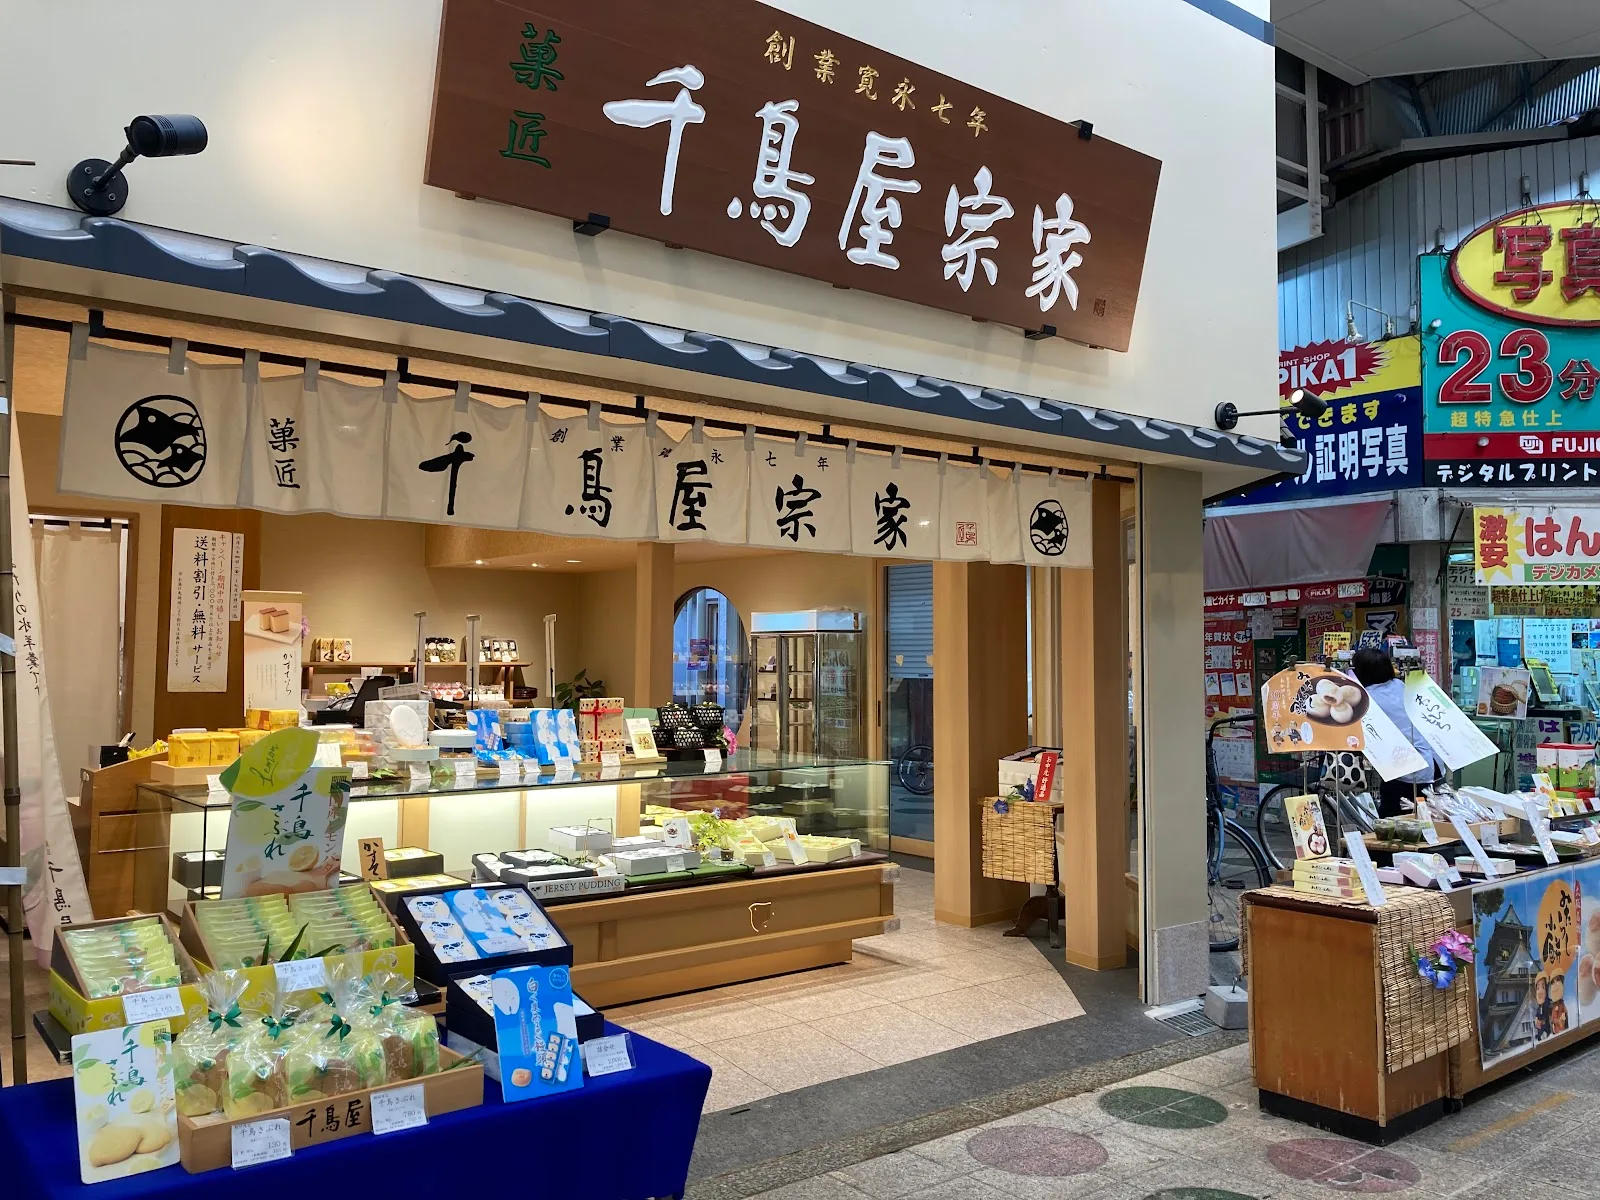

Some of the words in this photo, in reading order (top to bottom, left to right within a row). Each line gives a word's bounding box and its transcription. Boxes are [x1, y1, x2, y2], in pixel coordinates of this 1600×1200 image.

[498, 23, 566, 170] 菓匠
[763, 30, 990, 138] 創業寛永七年
[602, 64, 1093, 313] 千鳥屋宗家
[1494, 221, 1600, 303] 写真
[1303, 352, 1331, 364] SHOP
[1281, 399, 1381, 430] できます
[1450, 409, 1563, 428] 超特急仕上
[267, 417, 301, 490] 菓匠
[1436, 462, 1598, 484] デジタルプリント
[418, 430, 911, 552] 千鳥屋宗家
[1479, 514, 1509, 570] 激安
[1524, 515, 1600, 558] はん
[1491, 588, 1544, 603] 超特急仕上げ
[1532, 564, 1600, 581] デジカメ
[191, 535, 209, 684] 送料割引・無料サービス
[1205, 631, 1231, 643] 年賀状
[1425, 634, 1437, 675] 年賀状印
[264, 804, 289, 861] さぶれ
[290, 783, 314, 840] 千鳥
[543, 883, 577, 895] JERSEY
[578, 878, 621, 890] PUDDING
[104, 1058, 126, 1107] さぶれ
[121, 1039, 147, 1087] 千鳥
[296, 1098, 363, 1138] 千鳥屋
